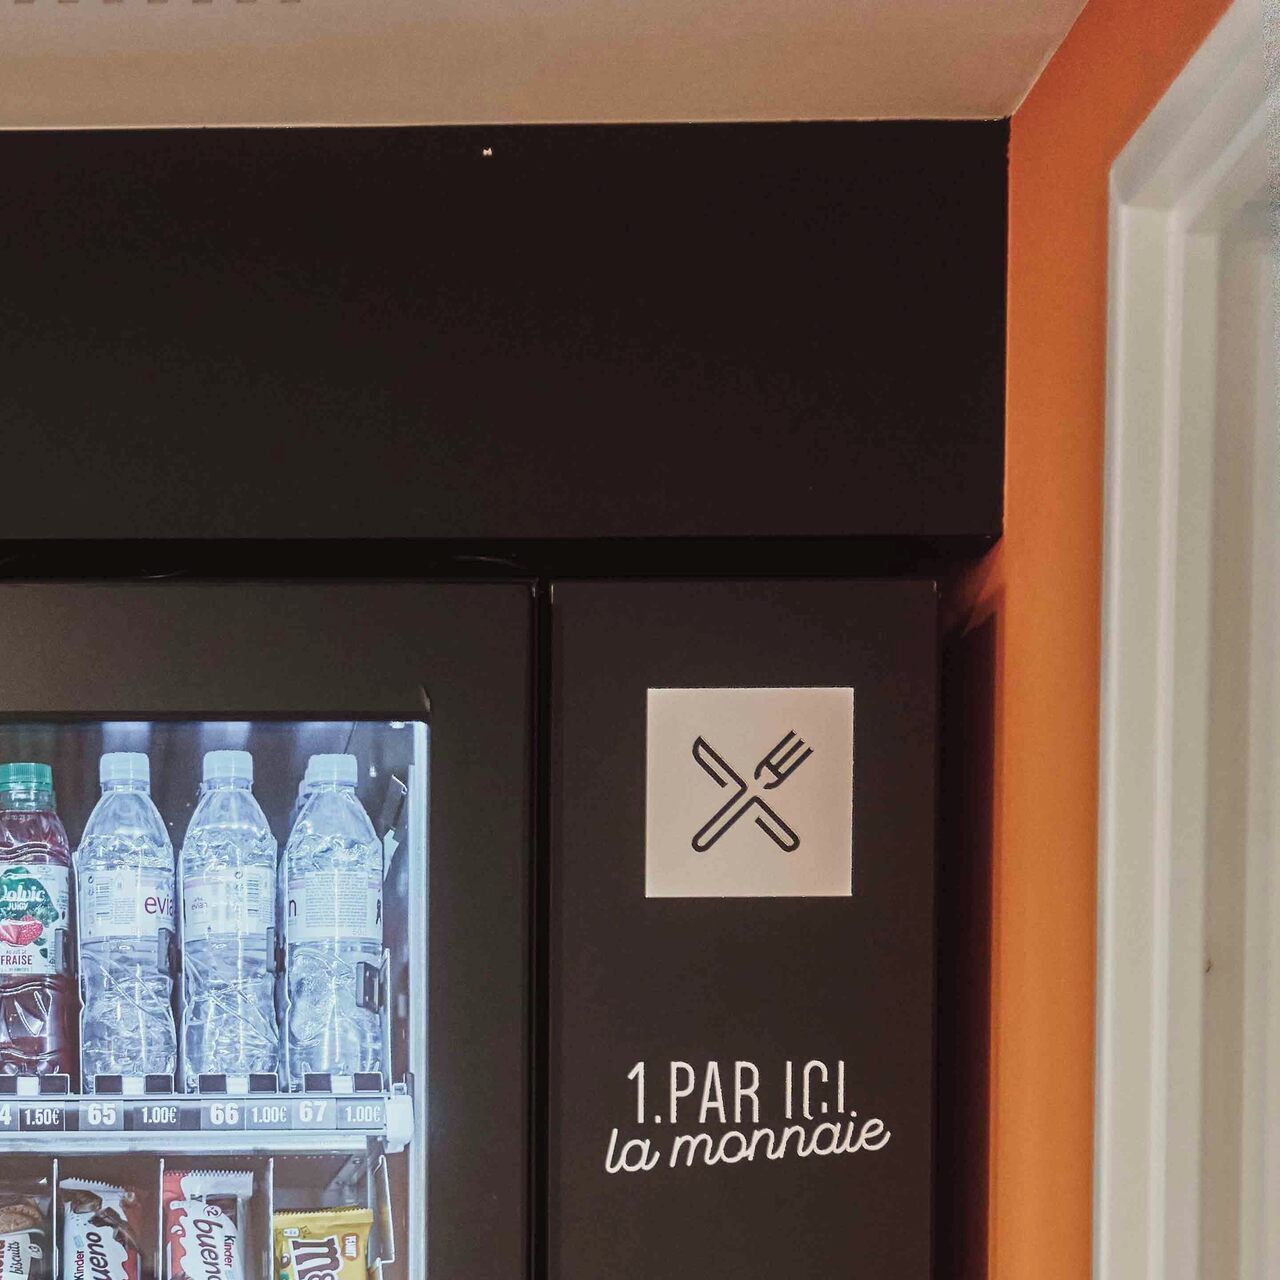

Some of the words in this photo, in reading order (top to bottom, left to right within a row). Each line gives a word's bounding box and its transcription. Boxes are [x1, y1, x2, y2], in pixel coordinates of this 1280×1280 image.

[0, 954, 33, 966] FRAISE
[24, 1107, 60, 1126] 1.50€
[87, 1103, 116, 1126] 65
[141, 1106, 177, 1125] 1.00€
[605, 1127, 661, 1174] la
[669, 1111, 891, 1168] monnaie
[9, 1240, 24, 1275] biscuits
[223, 1234, 237, 1269] Kinder
